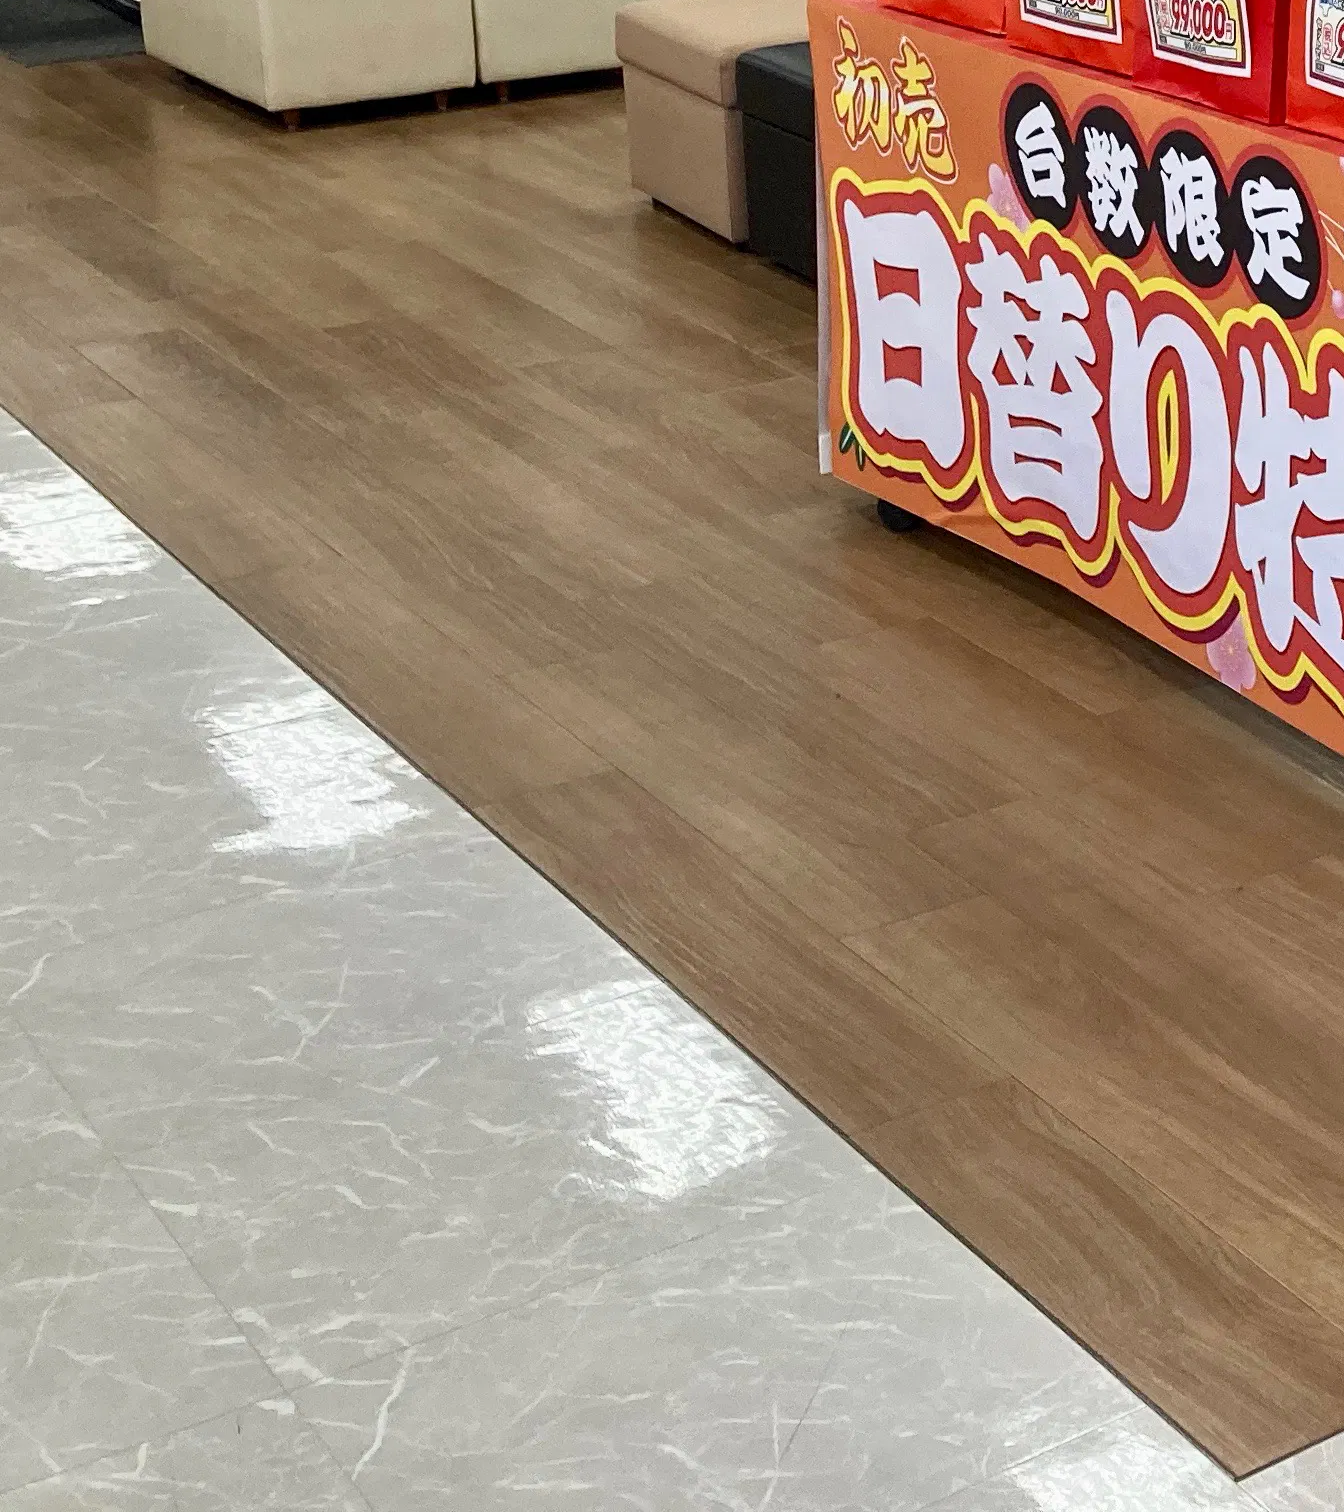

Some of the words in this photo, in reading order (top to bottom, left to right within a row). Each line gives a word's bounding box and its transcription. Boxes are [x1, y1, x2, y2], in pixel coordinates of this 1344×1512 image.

[835, 18, 958, 180] 初売
[1013, 98, 1314, 301] 台数限定
